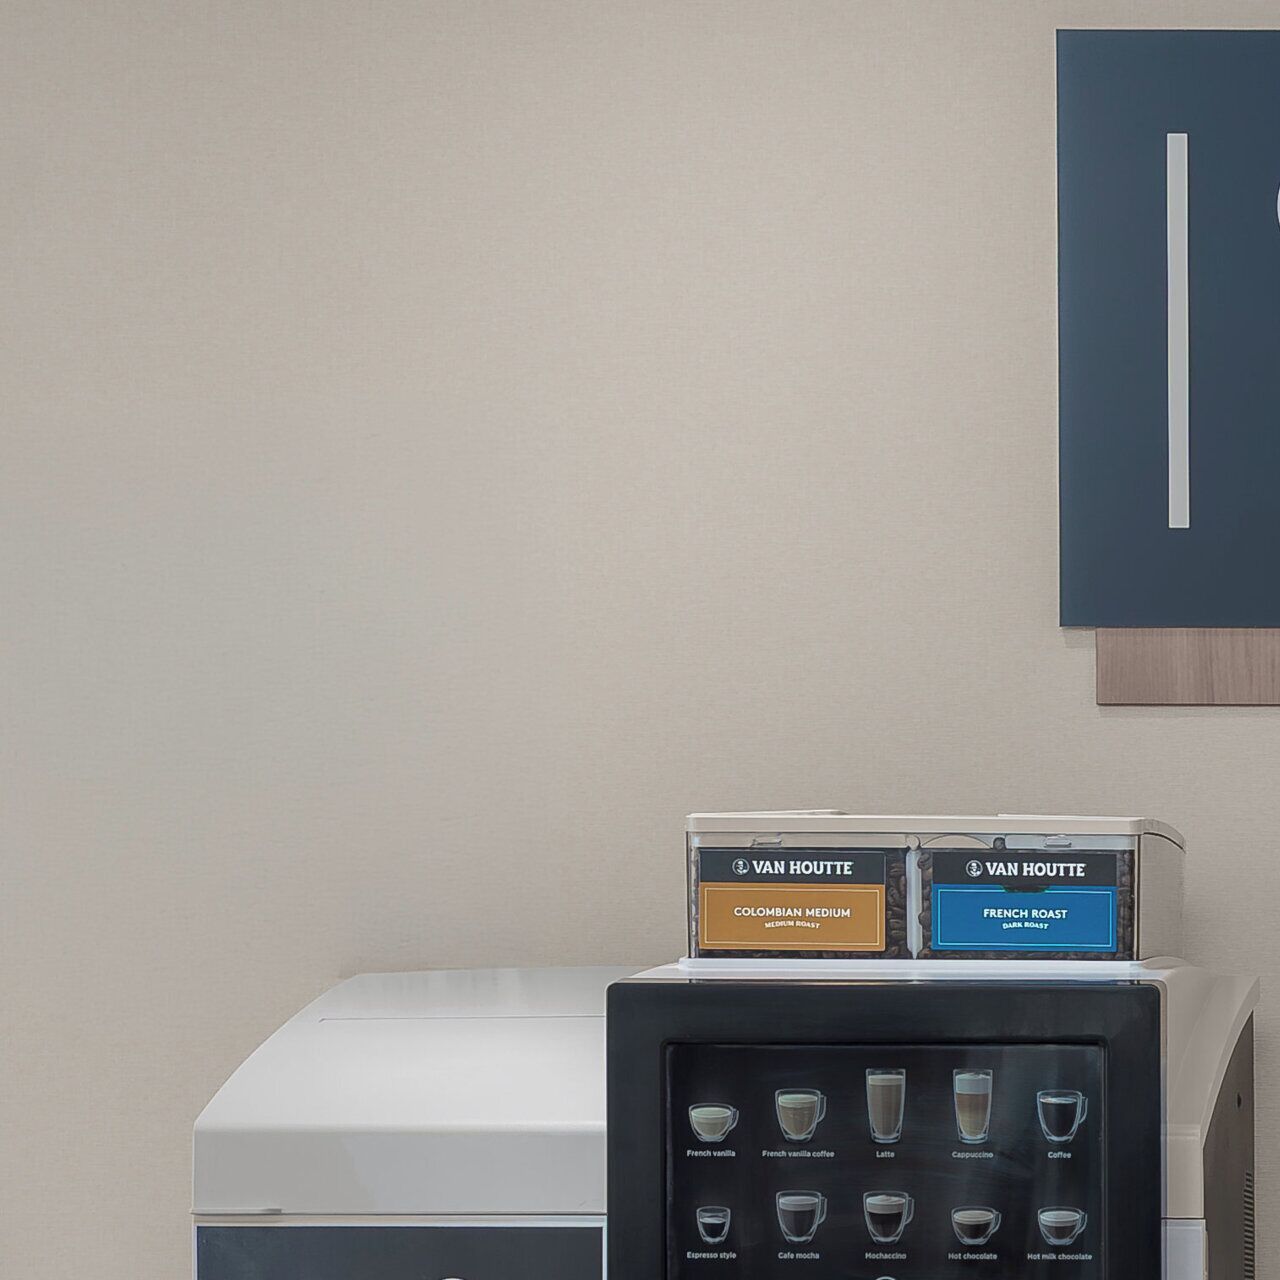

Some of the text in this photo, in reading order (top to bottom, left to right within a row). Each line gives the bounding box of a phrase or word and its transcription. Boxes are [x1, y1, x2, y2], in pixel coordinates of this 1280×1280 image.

[752, 860, 853, 875] VAN HOUTTE
[986, 862, 1086, 877] VAN HOUTTE
[734, 907, 851, 918] COLOMBIAN MEDIUM
[983, 909, 1068, 919] FRENCH ROAST
[764, 921, 821, 930] MEDIUM ROAST
[1002, 922, 1049, 930] DARK ROAST
[865, 1252, 907, 1260] Mochaccino
